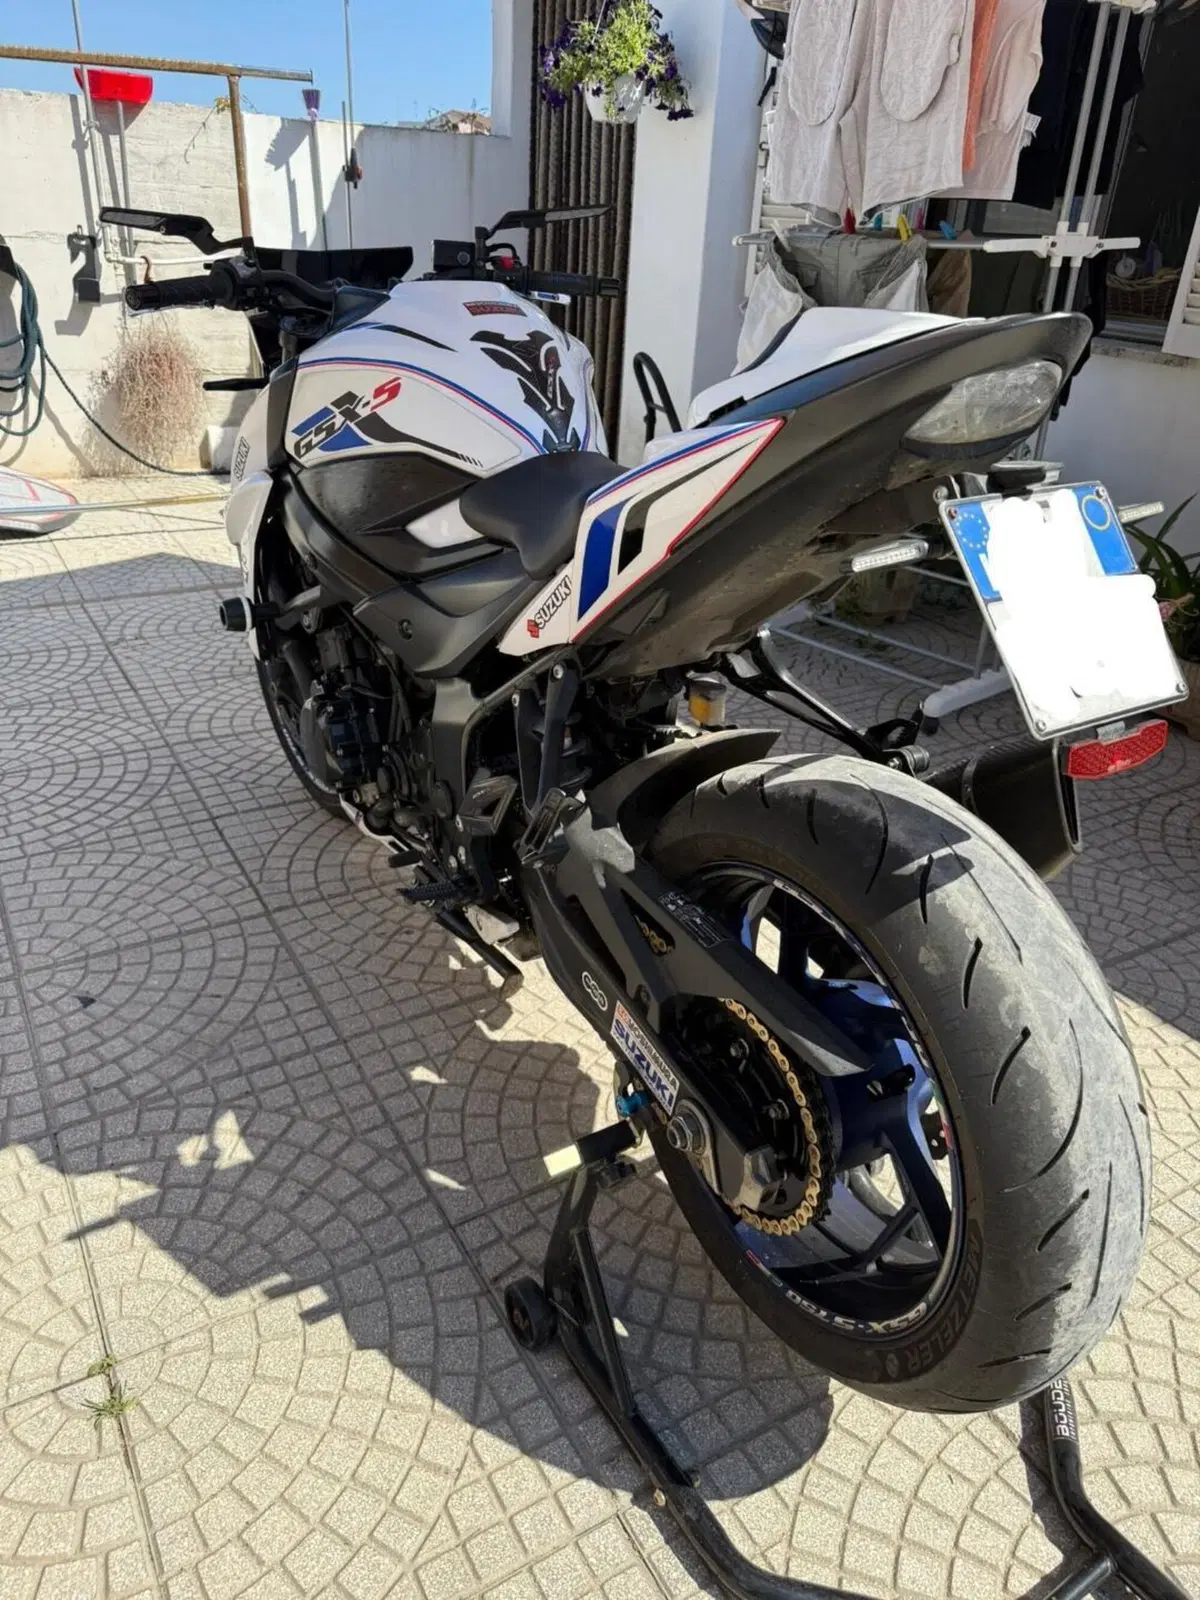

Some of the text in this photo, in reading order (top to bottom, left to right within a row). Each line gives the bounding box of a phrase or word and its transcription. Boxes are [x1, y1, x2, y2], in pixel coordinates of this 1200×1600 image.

[233, 436, 250, 481] SUZUKI
[293, 376, 402, 459] GSX-S
[534, 574, 572, 629] SUZUKI
[614, 1018, 675, 1107] SUZUKI
[904, 1233, 980, 1374] METZELER
